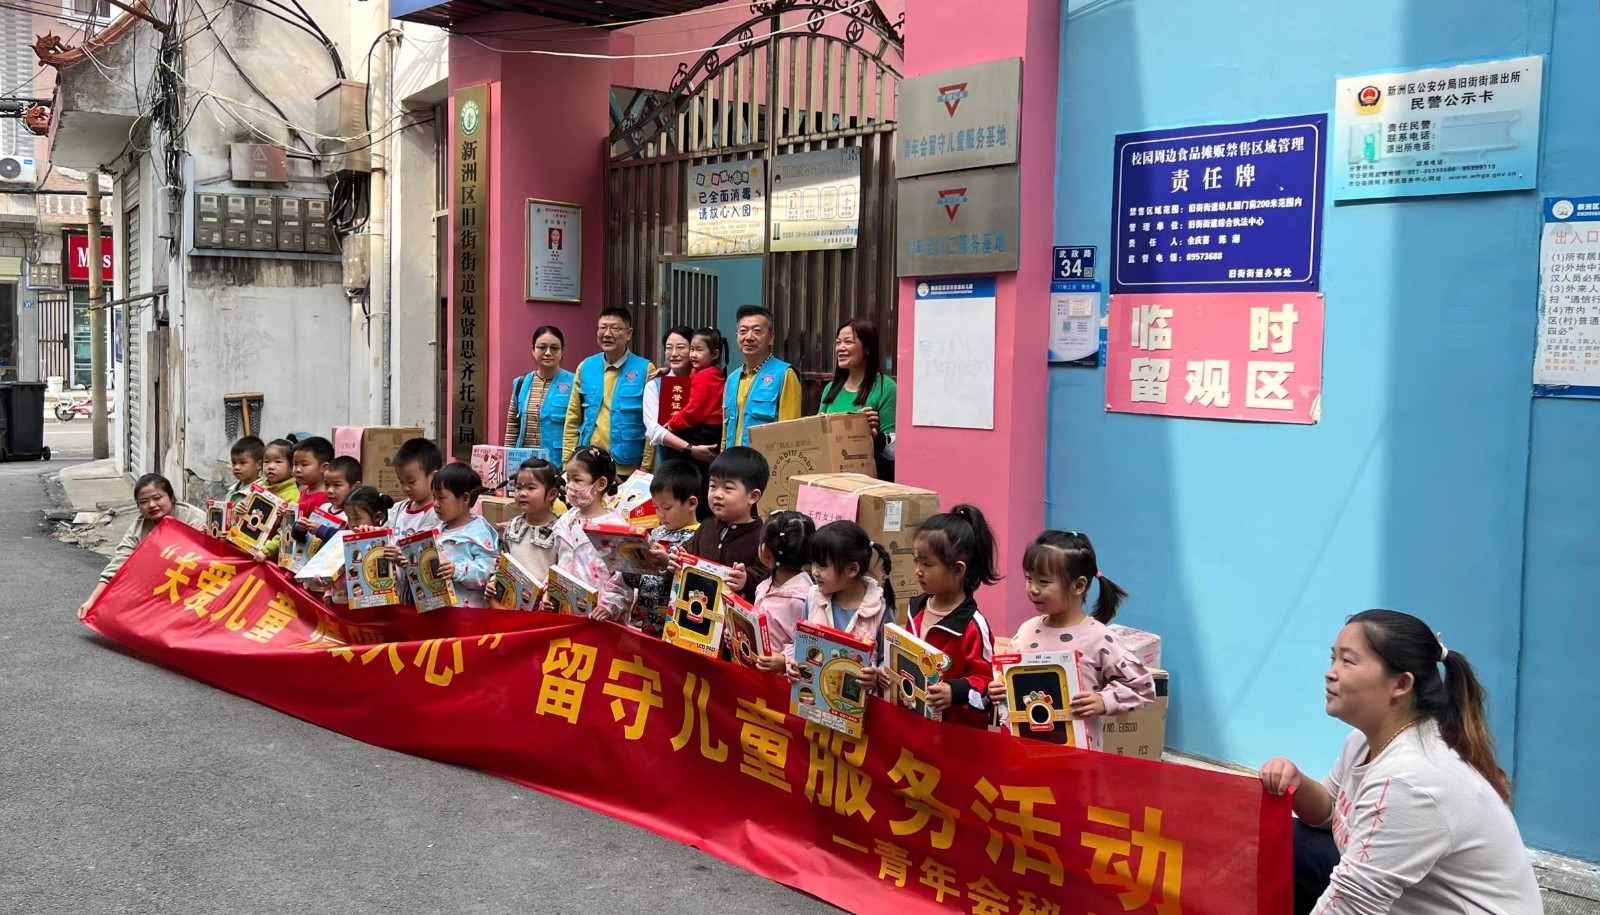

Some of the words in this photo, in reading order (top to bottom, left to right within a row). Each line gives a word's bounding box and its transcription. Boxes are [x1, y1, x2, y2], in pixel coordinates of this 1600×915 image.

[1410, 90, 1494, 110] 民警公示卡
[904, 124, 1007, 159] 青年会留守儿童服务基地
[1131, 136, 1305, 166] 校园周边食品摊贩禁售区域管理
[1170, 163, 1256, 194] 责任牌
[698, 187, 752, 204] 已全面消毒
[698, 204, 752, 221] 请放心入园
[1555, 230, 1600, 245] 出入口
[1059, 249, 1092, 258] 武政路
[1552, 252, 1600, 263] (1)所有居
[1060, 259, 1082, 277] 34
[1551, 263, 1600, 273] (2)外地中
[459, 140, 478, 445] 新洲区旧街街道见贤思齐托育园
[1129, 358, 1298, 410] 留观区
[1138, 745, 1149, 756] PCS
[535, 637, 1184, 915] 留守儿童服务活动
